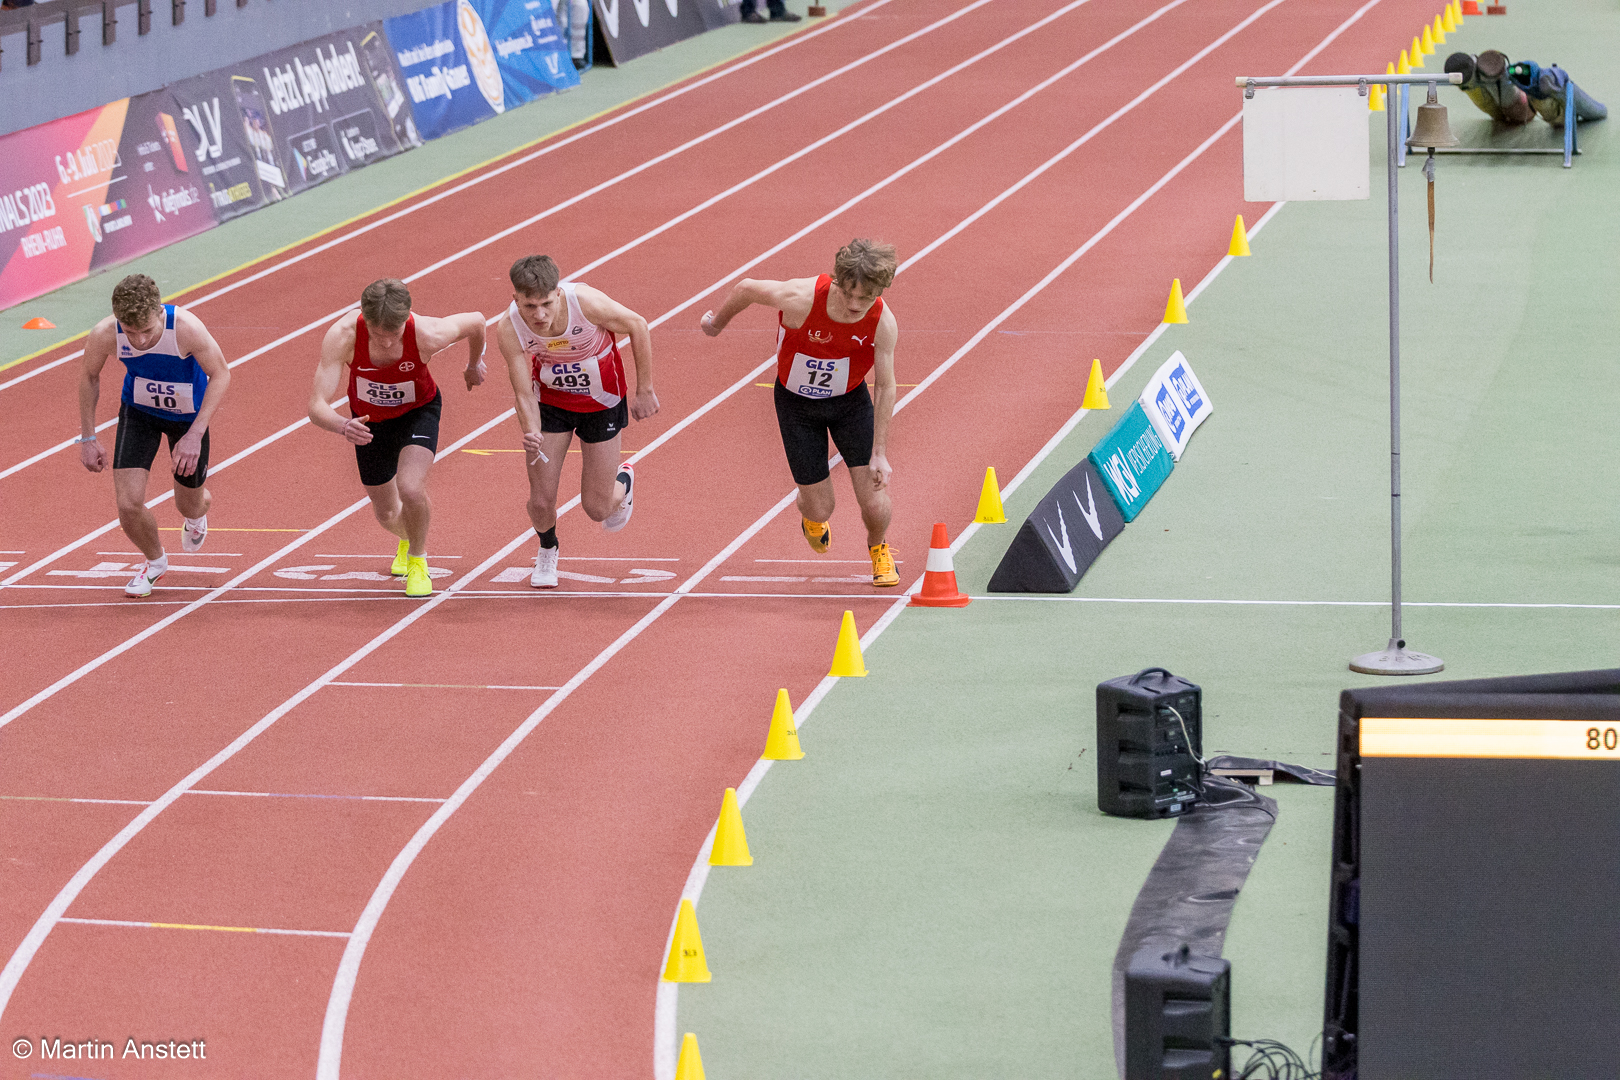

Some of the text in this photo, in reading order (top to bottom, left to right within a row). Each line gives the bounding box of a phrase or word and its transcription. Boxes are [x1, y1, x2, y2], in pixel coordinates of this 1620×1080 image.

[263, 63, 305, 115] Jetzt
[294, 57, 330, 113] App
[316, 41, 366, 95] laden!
[92, 138, 122, 172] 2023
[23, 181, 56, 222] 2023
[20, 225, 67, 258] RHEIN-RUHR
[552, 374, 591, 388] 493
[808, 371, 833, 388] 12
[150, 395, 177, 409] 10
[366, 390, 405, 400] 450
[1103, 446, 1142, 506] WGV
[1586, 727, 1618, 750] 80
